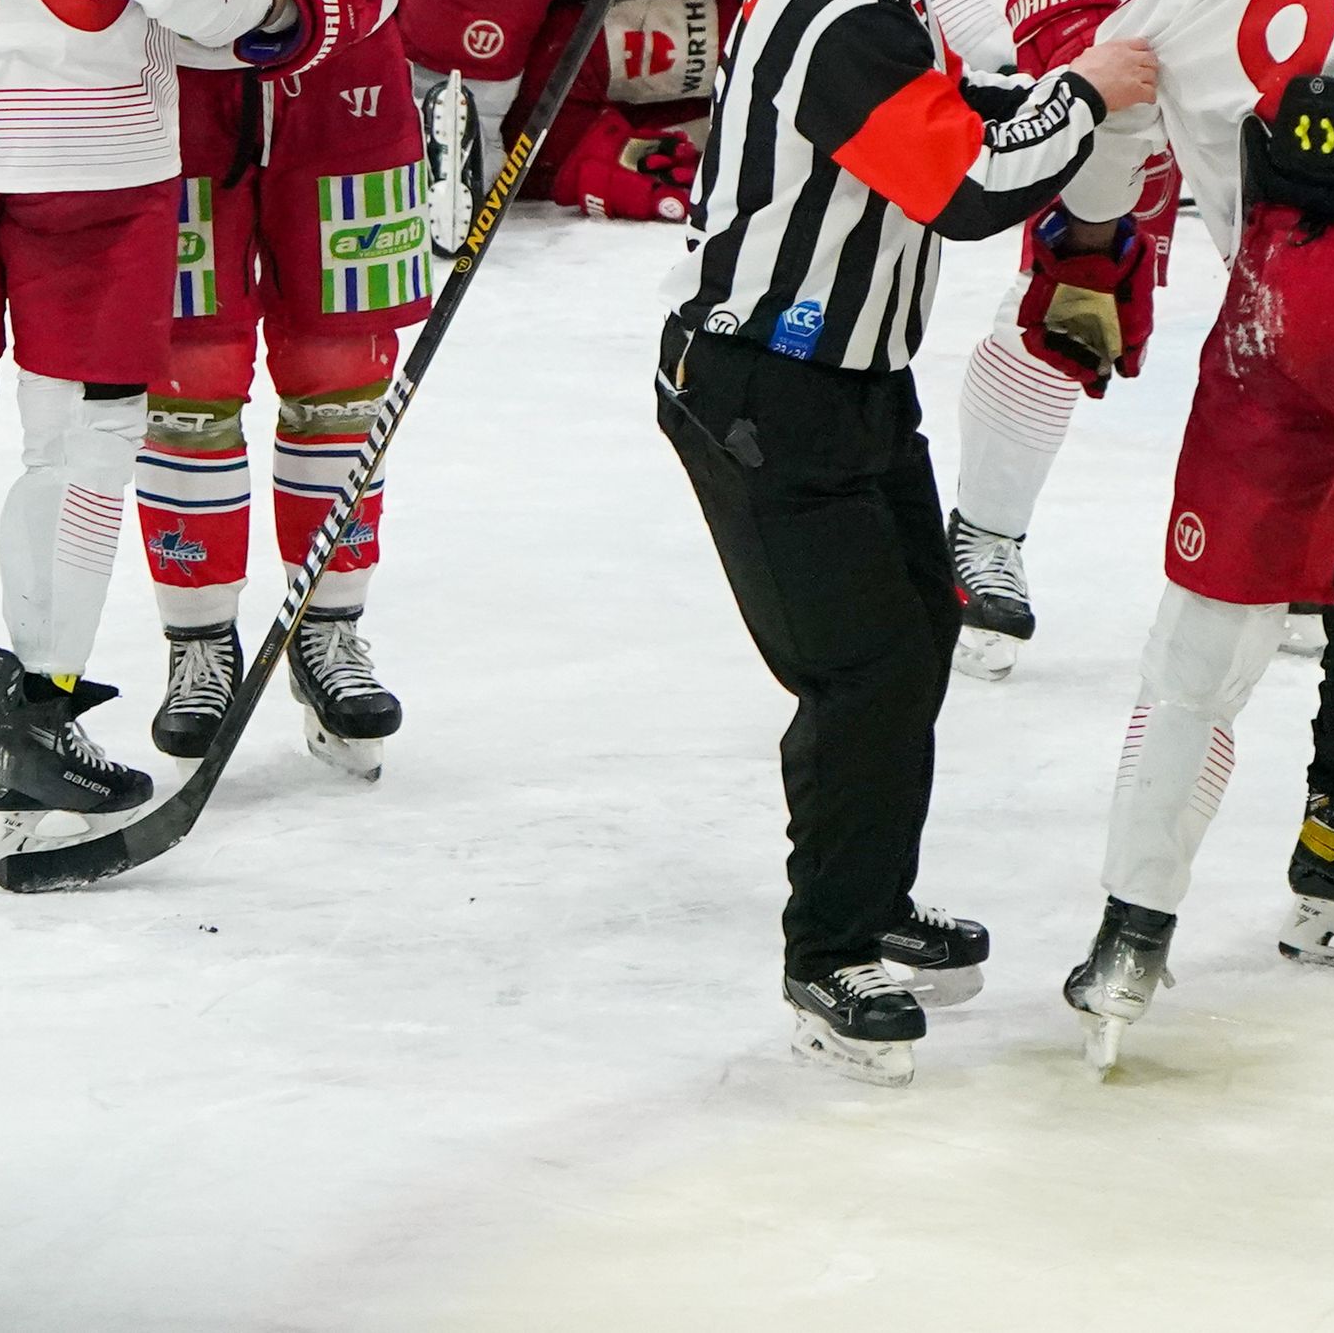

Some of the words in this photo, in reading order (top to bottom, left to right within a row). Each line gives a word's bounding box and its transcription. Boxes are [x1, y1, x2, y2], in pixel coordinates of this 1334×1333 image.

[466, 132, 534, 255] NOVIUM
[335, 220, 423, 252] avanti
[786, 306, 823, 330] ICE
[63, 769, 113, 797] BAUER
